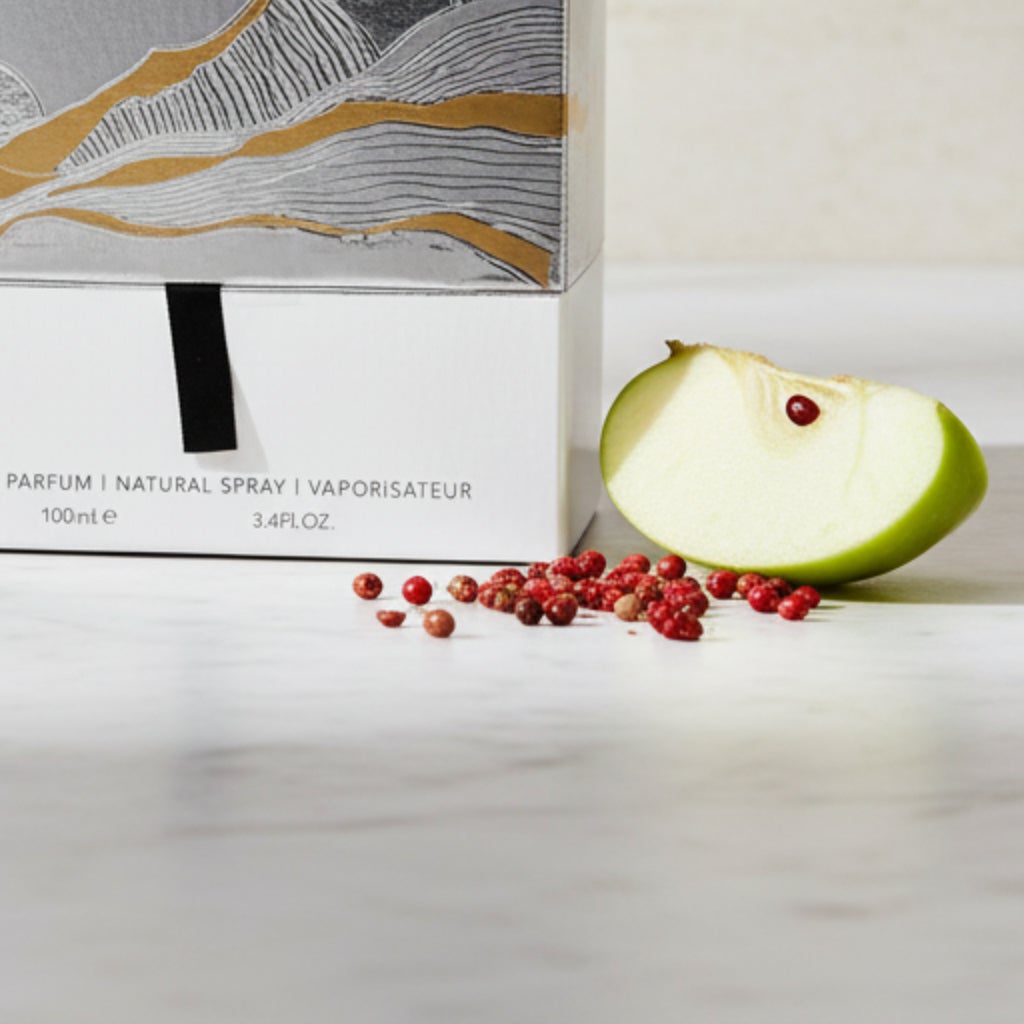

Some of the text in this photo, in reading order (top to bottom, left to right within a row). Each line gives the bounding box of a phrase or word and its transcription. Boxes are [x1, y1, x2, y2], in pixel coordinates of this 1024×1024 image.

[7, 473, 92, 491] PARFUM
[116, 475, 212, 493] NATURAL
[221, 476, 286, 495] SPRAY
